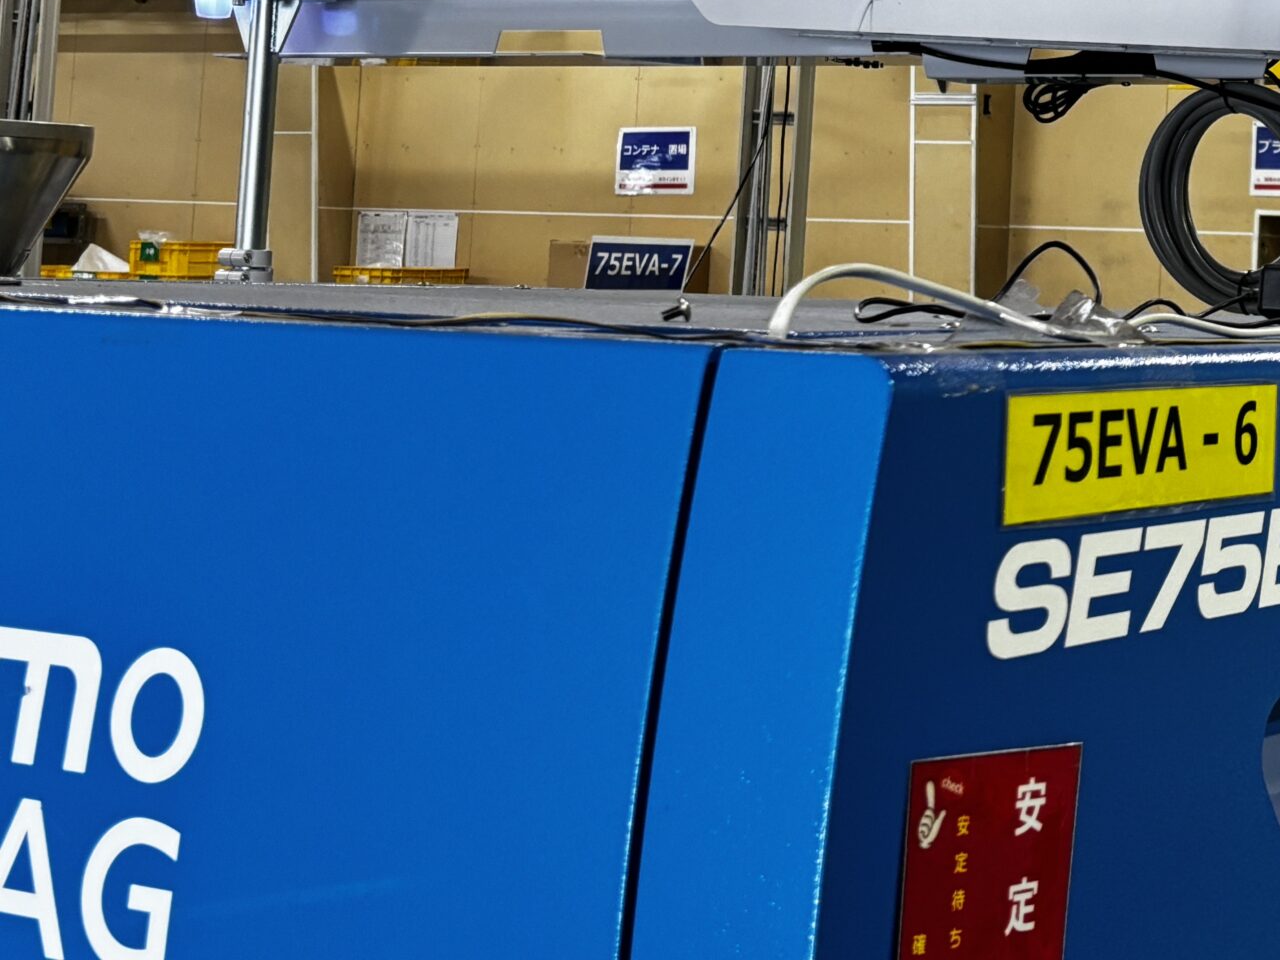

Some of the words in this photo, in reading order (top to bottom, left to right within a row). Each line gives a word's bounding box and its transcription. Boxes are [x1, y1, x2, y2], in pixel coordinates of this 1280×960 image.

[623, 144, 660, 156] コンテナ
[594, 251, 684, 276] 75EVA-7
[1032, 405, 1188, 487] 75EVA
[1233, 400, 1259, 466] 6
[940, 775, 965, 796] check
